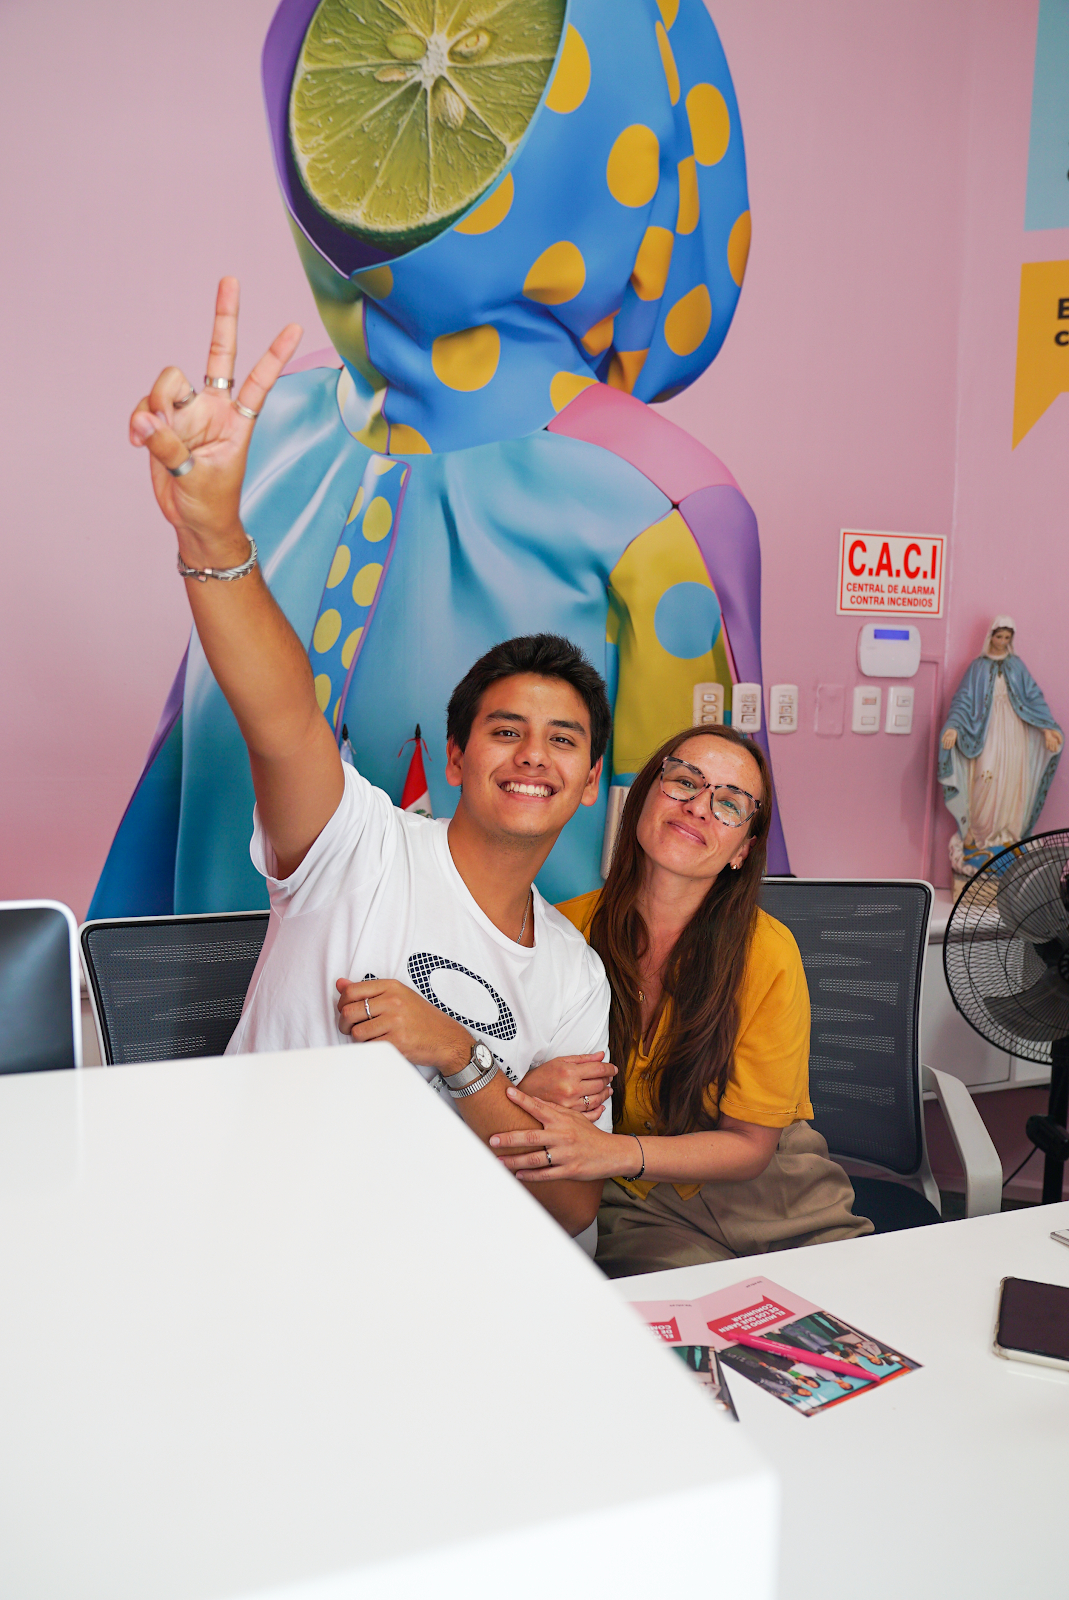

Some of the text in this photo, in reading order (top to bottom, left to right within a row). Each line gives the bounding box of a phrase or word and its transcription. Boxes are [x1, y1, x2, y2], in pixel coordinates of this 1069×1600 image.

[848, 539, 937, 580] C.A.C.I
[846, 582, 935, 595] CENTRAL DE ALARMA
[850, 595, 933, 608] CONTRA INCENDIOS
[718, 1305, 780, 1333] DE LOS QUE SABEN
[731, 1303, 774, 1323] COMUNICAR
[740, 1309, 786, 1331] EL MUNDO ES
